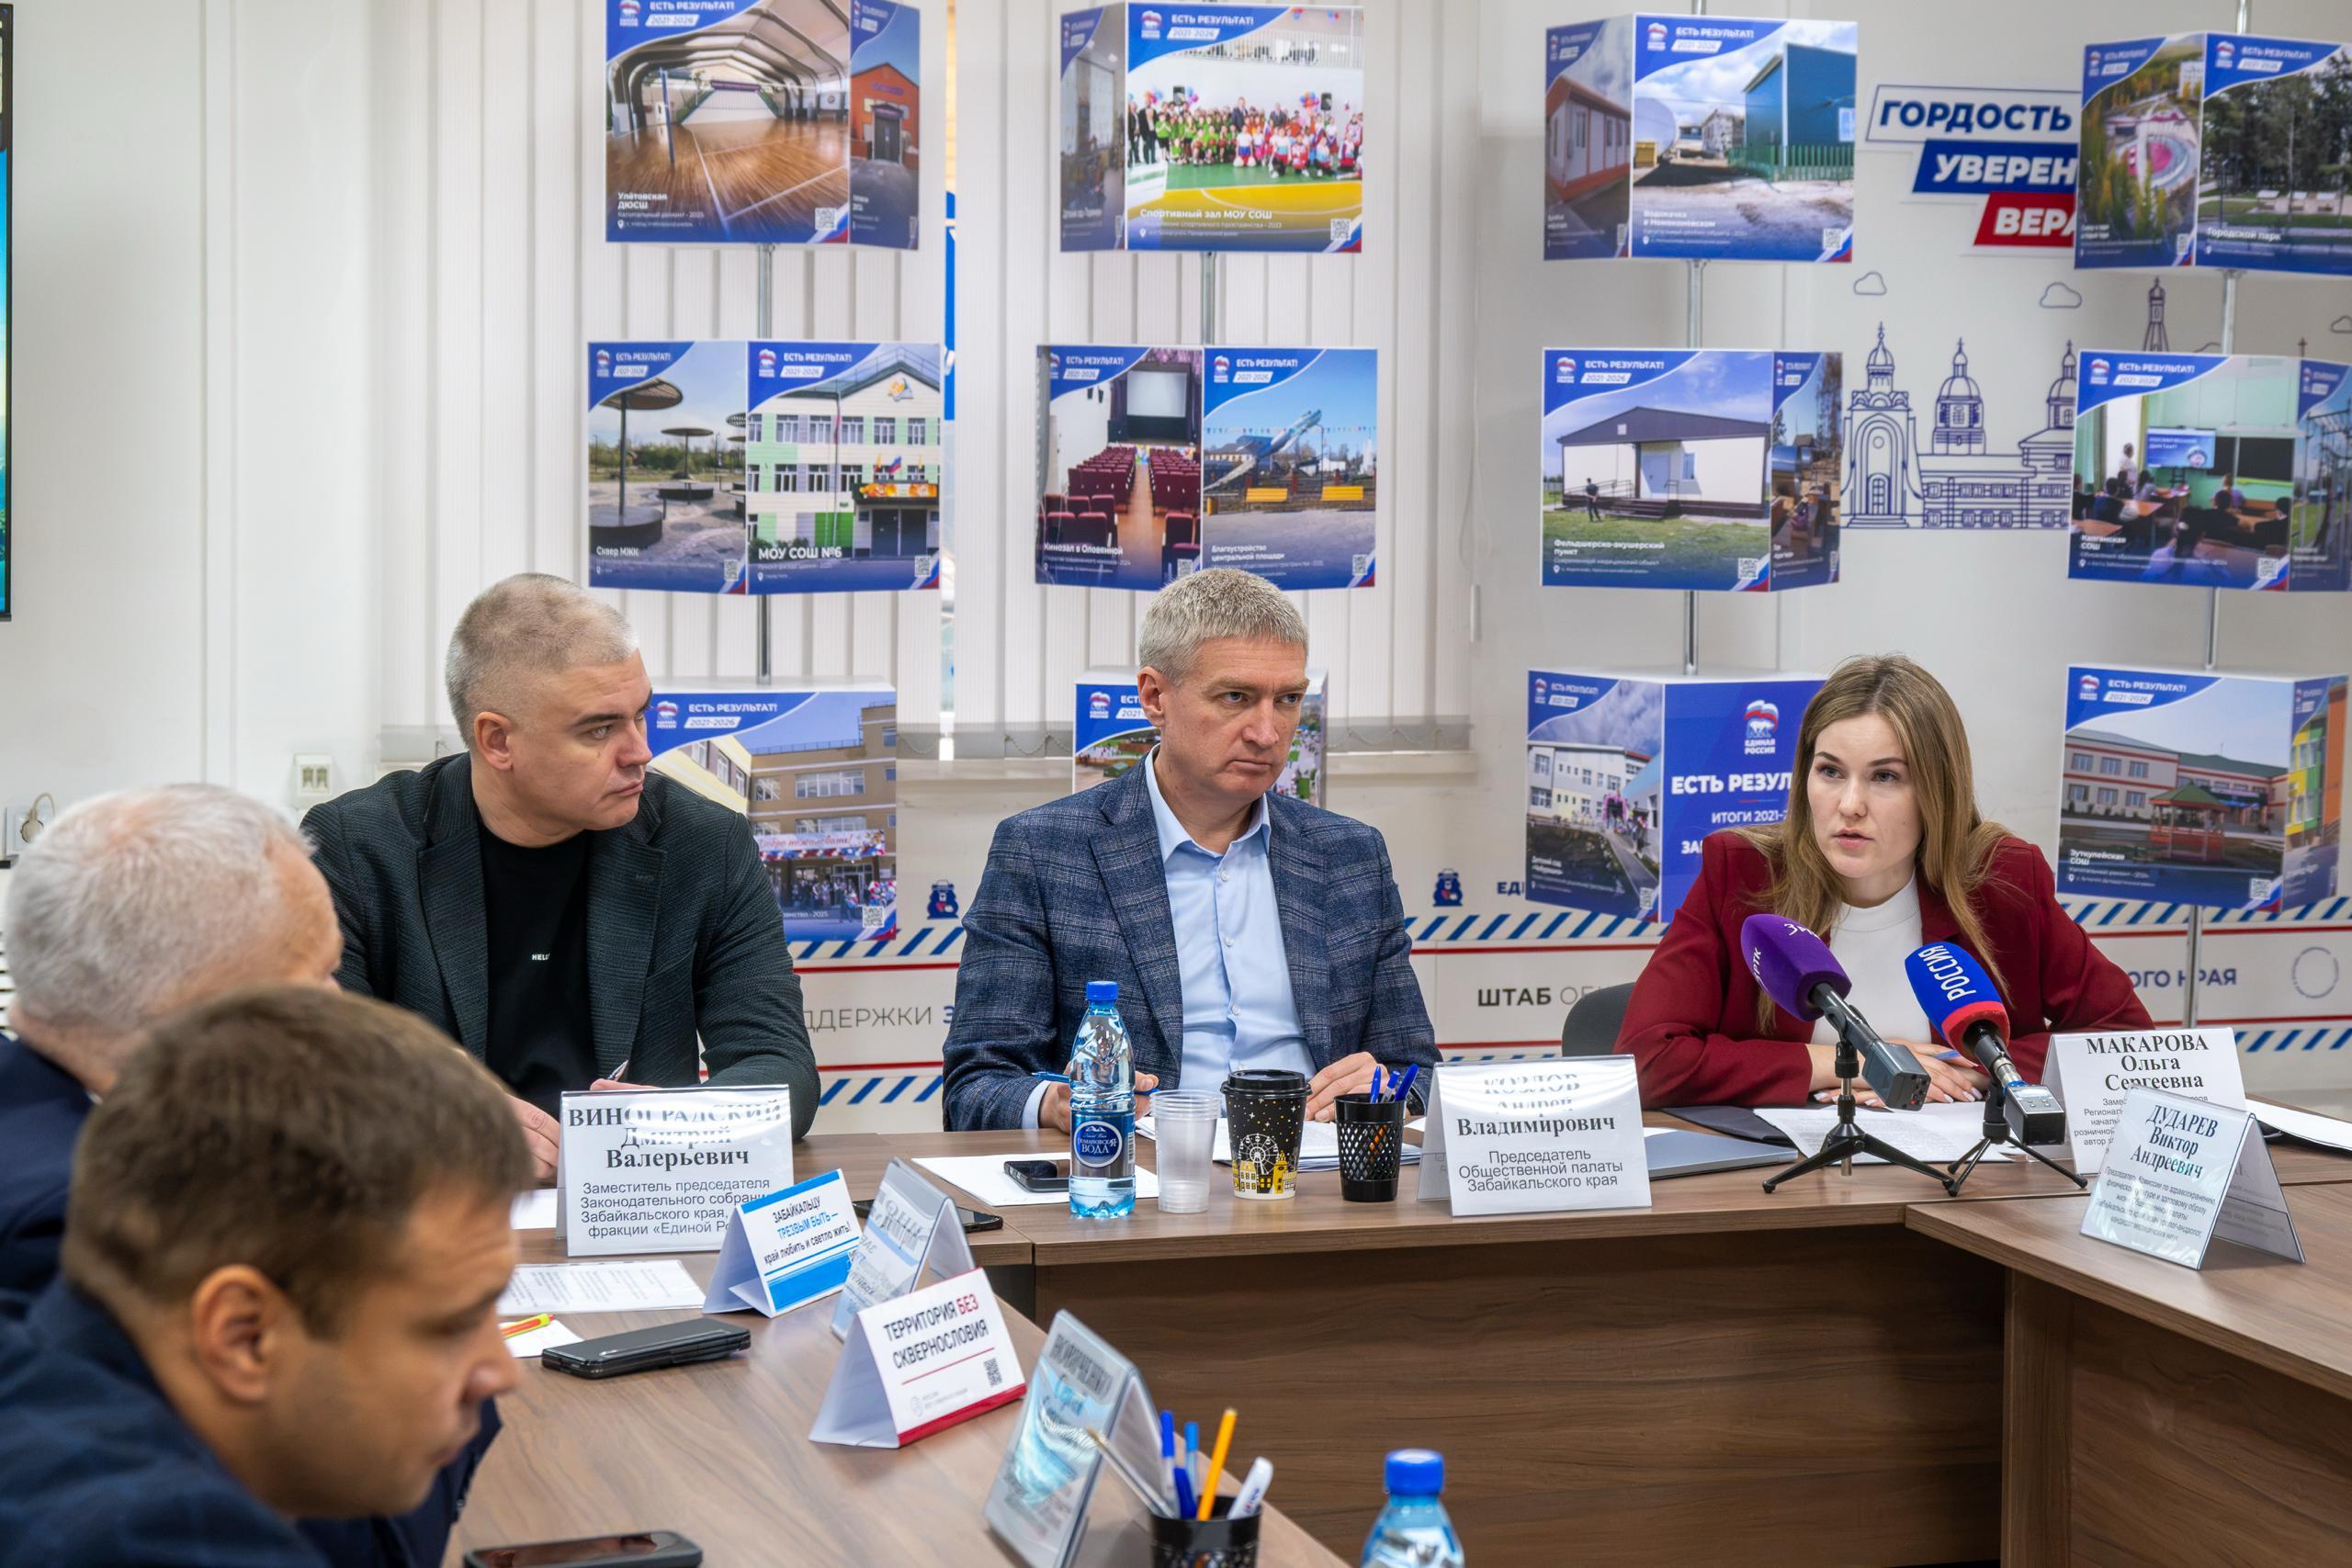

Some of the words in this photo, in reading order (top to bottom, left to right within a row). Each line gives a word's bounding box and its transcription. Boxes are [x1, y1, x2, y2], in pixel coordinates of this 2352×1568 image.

[650, 1, 674, 10] ЕСТЬ
[676, 1, 734, 10] РЕЗУЛЬТАТ!
[1171, 15, 1195, 25] ЕСТЬ
[1198, 16, 1254, 26] РЕЗУЛЬТАТ!
[1172, 28, 1215, 38] 2021-2026
[1676, 27, 1699, 36] ЕСТЬ
[1880, 100, 2072, 133] ГОРДОСТЬ
[617, 192, 667, 200] Улётовская
[617, 201, 648, 209] ДЮСШ
[1140, 209, 1203, 220] Спортивный
[1204, 210, 1221, 219] зал
[1224, 210, 1246, 219] МОУ
[1249, 210, 1272, 220] СОШ
[2208, 227, 2256, 239] Городской
[2259, 231, 2281, 243] парк
[616, 353, 631, 362] ЕСТЬ
[633, 353, 671, 362] РЕЗУЛЬТАТ!
[784, 353, 804, 362] ЕСТЬ
[806, 353, 852, 362] РЕЗУЛЬТАТ!
[1066, 356, 1082, 365] ЕСТЬ
[1084, 356, 1124, 366] РЕЗУЛЬТАТ!
[1236, 358, 1254, 367] ЕСТЬ
[1256, 358, 1298, 367] РЕЗУЛЬТАТ!
[1585, 360, 1609, 369] ЕСТЬ
[1610, 361, 1664, 369] РЕЗУЛЬТАТ!
[2118, 363, 2141, 372] ЕСТЬ
[2143, 364, 2195, 373] РЕЗУЛЬТАТ!
[1586, 374, 1627, 382] 2021-2026
[1044, 542, 1074, 552] Кинозал
[1212, 544, 1267, 555] Благоустройство
[1554, 539, 1665, 550] Фельдшерско-акушерский
[2080, 542, 2100, 550] СОШ
[596, 547, 618, 558] Сквер
[620, 547, 639, 557] МЖК
[758, 548, 786, 559] МОУ
[788, 547, 819, 558] СОШ
[821, 547, 842, 558] №6
[1212, 551, 1253, 562] центральной
[1255, 552, 1285, 561] площади
[2108, 679, 2132, 689] ЕСТЬ
[2132, 681, 2187, 693] РЕЗУЛЬТАТ!
[689, 704, 714, 713] ЕСТЬ
[717, 703, 778, 713] РЕЗУЛЬТАТ!
[690, 718, 736, 727] 2021-2026
[1745, 739, 1776, 747] ЕДИНАЯ
[1745, 746, 1776, 754] РОССИЯ
[1671, 775, 1724, 795] ЕСТЬ
[1712, 811, 1752, 823] ИТОГИ
[2069, 857, 2090, 866] СОШ
[1918, 944, 1976, 1001] РОССИЯ
[1477, 987, 1551, 1007] ШТАБ
[2086, 1033, 2210, 1055] МАКАРОВА
[2120, 1055, 2181, 1072] Ольга
[2105, 1073, 2204, 1091] Сергеевна
[1457, 1116, 1615, 1136] Владимирович
[2145, 1104, 2219, 1138] ДУДАРЕВ
[2149, 1126, 2199, 1159] Виктор
[1081, 1145, 1109, 1154] ВОДА
[606, 1149, 749, 1171] Валерьевич
[1488, 1150, 1591, 1164] Председатель
[2131, 1146, 2203, 1179] Андреевич
[1459, 1163, 1567, 1179] Общественной
[1571, 1161, 1623, 1174] палаты
[582, 1182, 672, 1194] Заместитель
[675, 1179, 770, 1193] председателя
[1468, 1178, 1581, 1192] Забайкальского
[1586, 1176, 1618, 1188] края
[580, 1194, 706, 1209] Законодательного
[773, 1196, 820, 1224] ЗАБАЙКАЛЬЦУ
[581, 1210, 689, 1224] Забайкальского
[694, 1209, 729, 1221] края,
[588, 1225, 649, 1238] фракции
[653, 1222, 712, 1235] «Единой
[777, 1219, 810, 1239] ТРЕЗВЫМ
[810, 1212, 831, 1227] БЫТЬ
[763, 1249, 779, 1266] край
[780, 1243, 806, 1258] любить
[810, 1231, 832, 1246] светло
[832, 1221, 852, 1236] жить!
[883, 1303, 958, 1341] ТЕРРИТОРИЯ
[956, 1293, 979, 1314] БЕЗ
[892, 1319, 989, 1369] СКВЕРНОСЛОВИЯ
